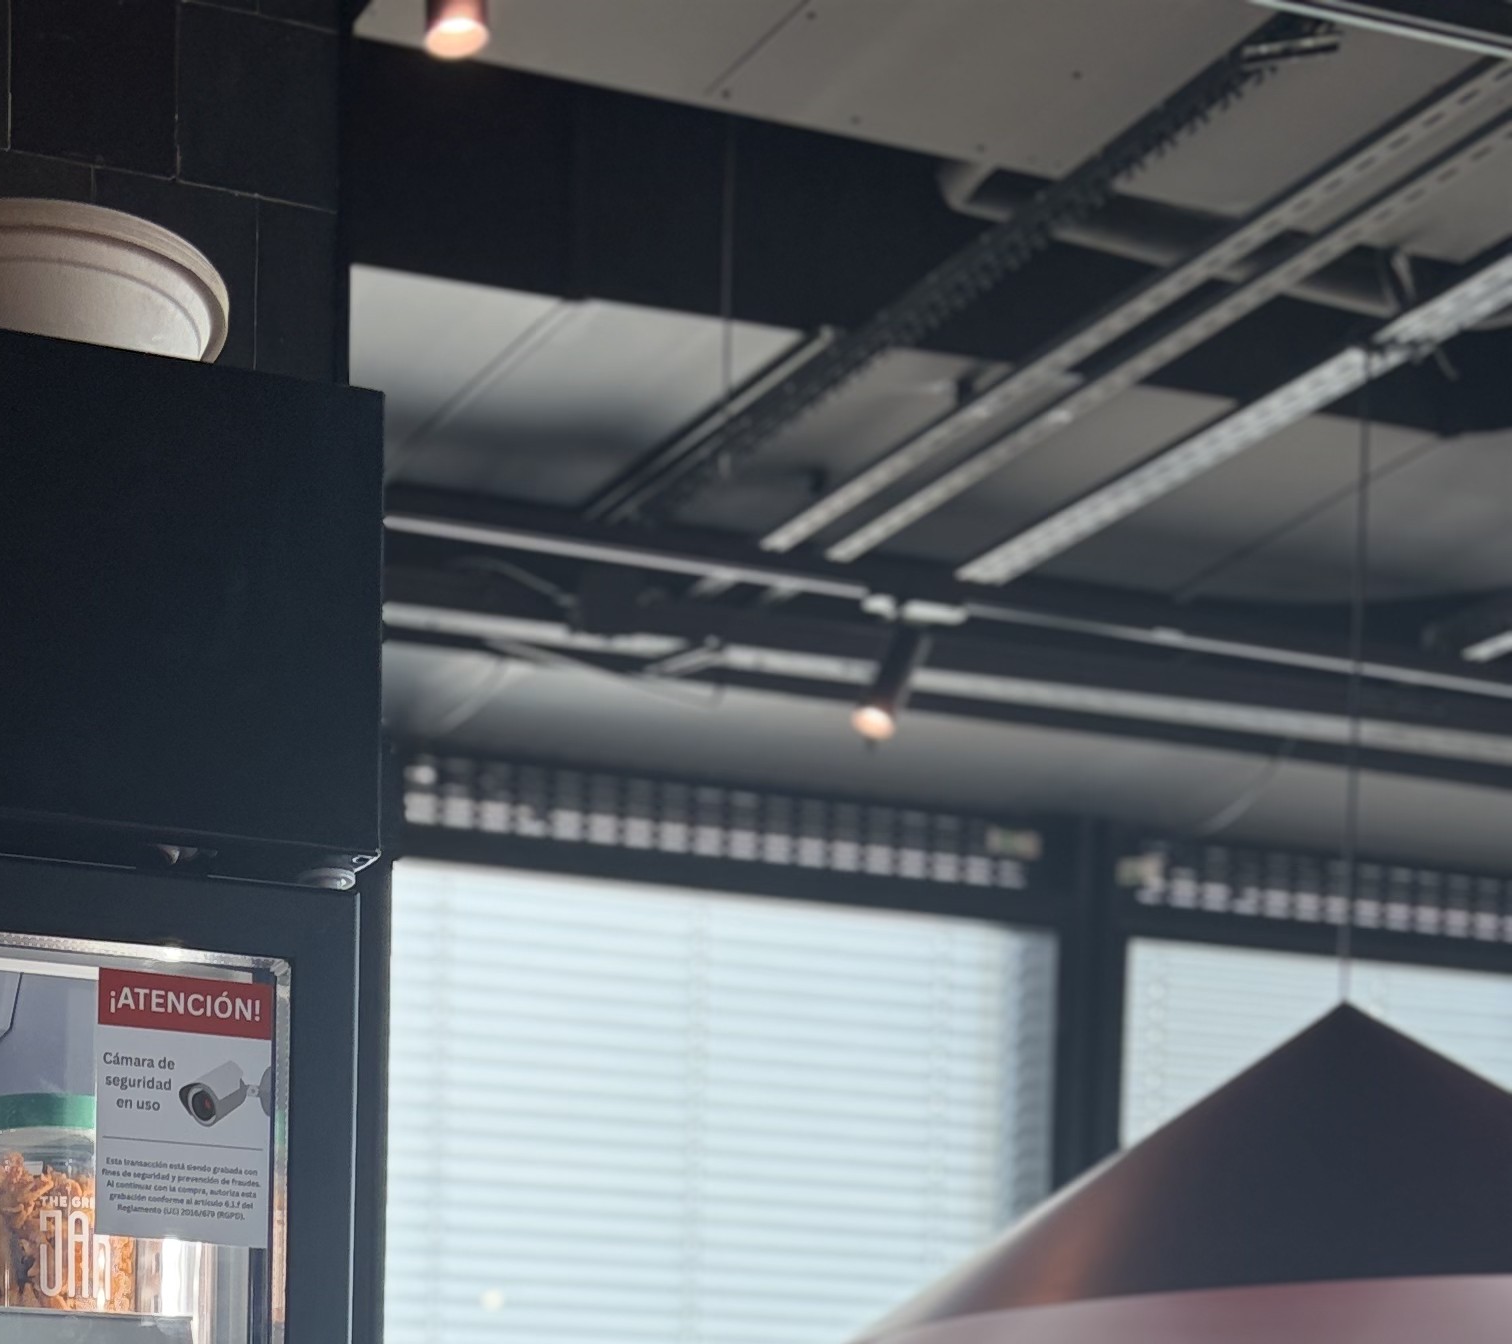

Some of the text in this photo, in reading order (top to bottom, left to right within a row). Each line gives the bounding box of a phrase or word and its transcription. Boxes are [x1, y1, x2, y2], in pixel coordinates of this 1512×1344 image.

[110, 986, 261, 1021] ¡ATENCIÓN!
[103, 1052, 175, 1070] Cámara de
[105, 1074, 172, 1091] seguridad
[116, 1097, 161, 1111] en uso
[40, 1196, 67, 1207] THE
